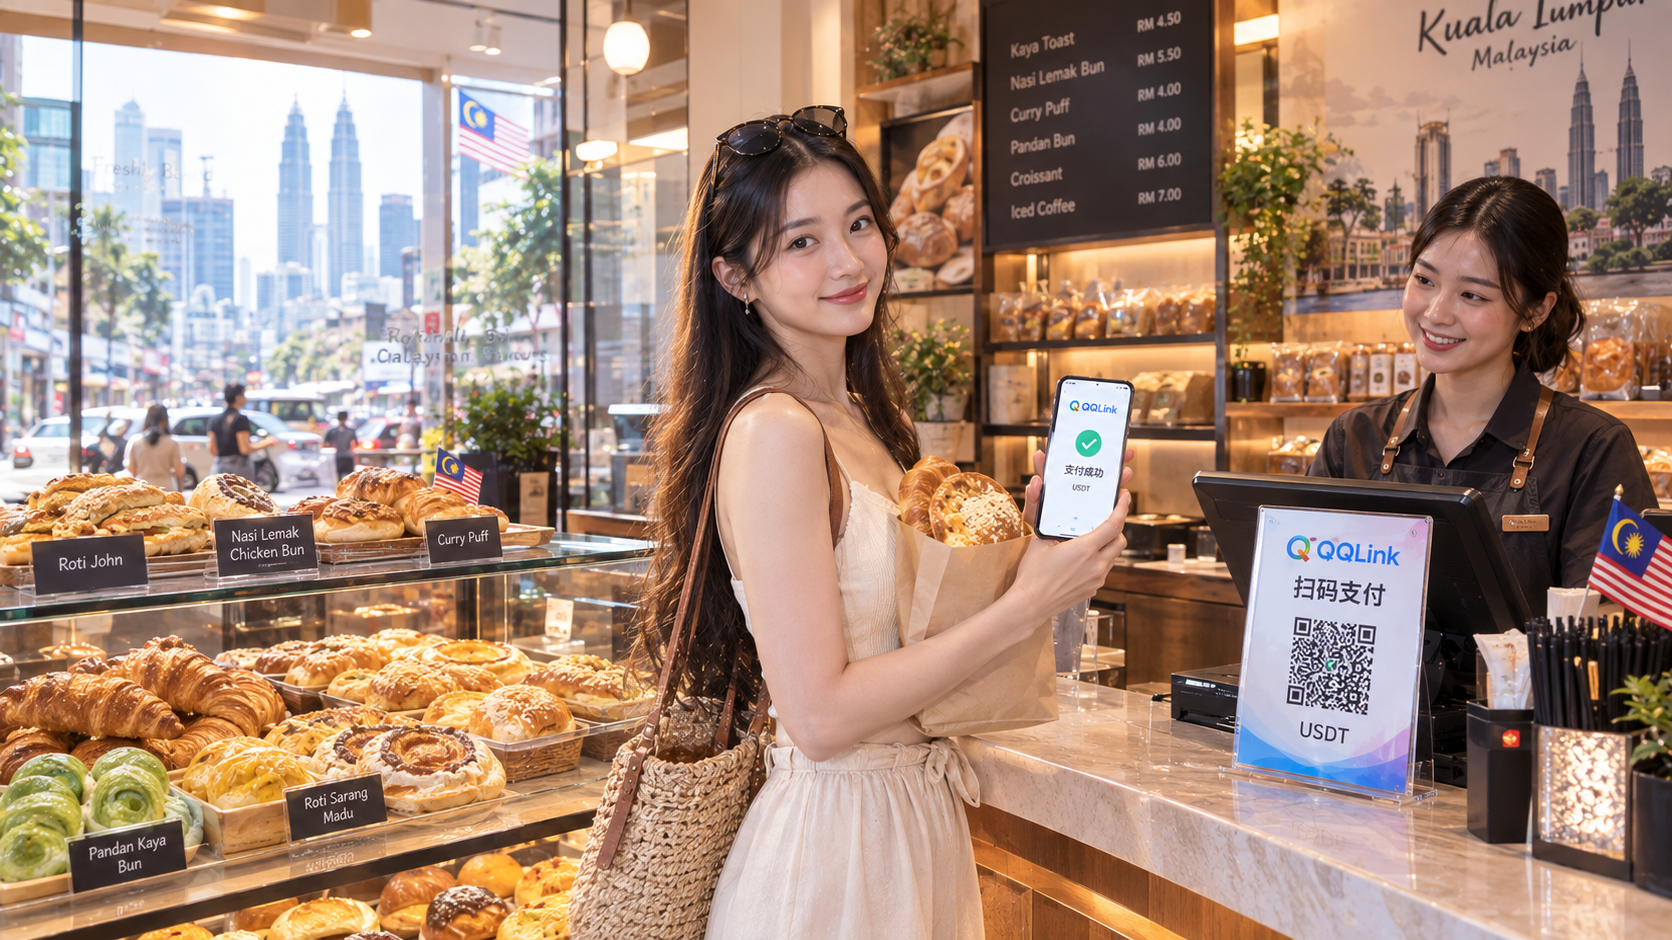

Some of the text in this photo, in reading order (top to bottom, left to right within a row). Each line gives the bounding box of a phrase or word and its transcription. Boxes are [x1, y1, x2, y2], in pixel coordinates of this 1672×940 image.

[1137, 11, 1181, 33] RM 4.50
[1418, 0, 1645, 56] Kuala Lumpu
[1010, 31, 1075, 59] Kaya Toast
[1471, 34, 1577, 71] Malaysia
[1137, 46, 1181, 67] RM 5.50
[1010, 60, 1105, 91] Nasi Lemak Bun
[1137, 82, 1181, 102] RM 4.00
[1010, 97, 1070, 123] Curry Puff
[1138, 117, 1181, 136] RM 4.00
[1010, 132, 1075, 155] Pandan Bun
[1138, 152, 1181, 171] RM 6.00
[1010, 167, 1063, 187] Croissant
[1138, 187, 1181, 205] RM 7.00
[1011, 198, 1075, 219] Iced Coffee
[1081, 402, 1118, 414] QQLink
[1064, 464, 1104, 478] 支付成功
[1072, 484, 1091, 492] USDT
[231, 525, 299, 543] Nasi Lemak
[437, 529, 489, 547] Curry Puff
[58, 553, 123, 572] Roti John
[230, 544, 305, 561] Chicken Bun
[1317, 540, 1401, 566] QQLink
[1293, 575, 1386, 607] 扫码支付
[1300, 721, 1350, 744] USDT
[304, 787, 369, 811] Roti Sarang
[323, 808, 354, 824] Madu
[88, 834, 167, 861] Pandan Kaya
[117, 858, 142, 874] Bun
